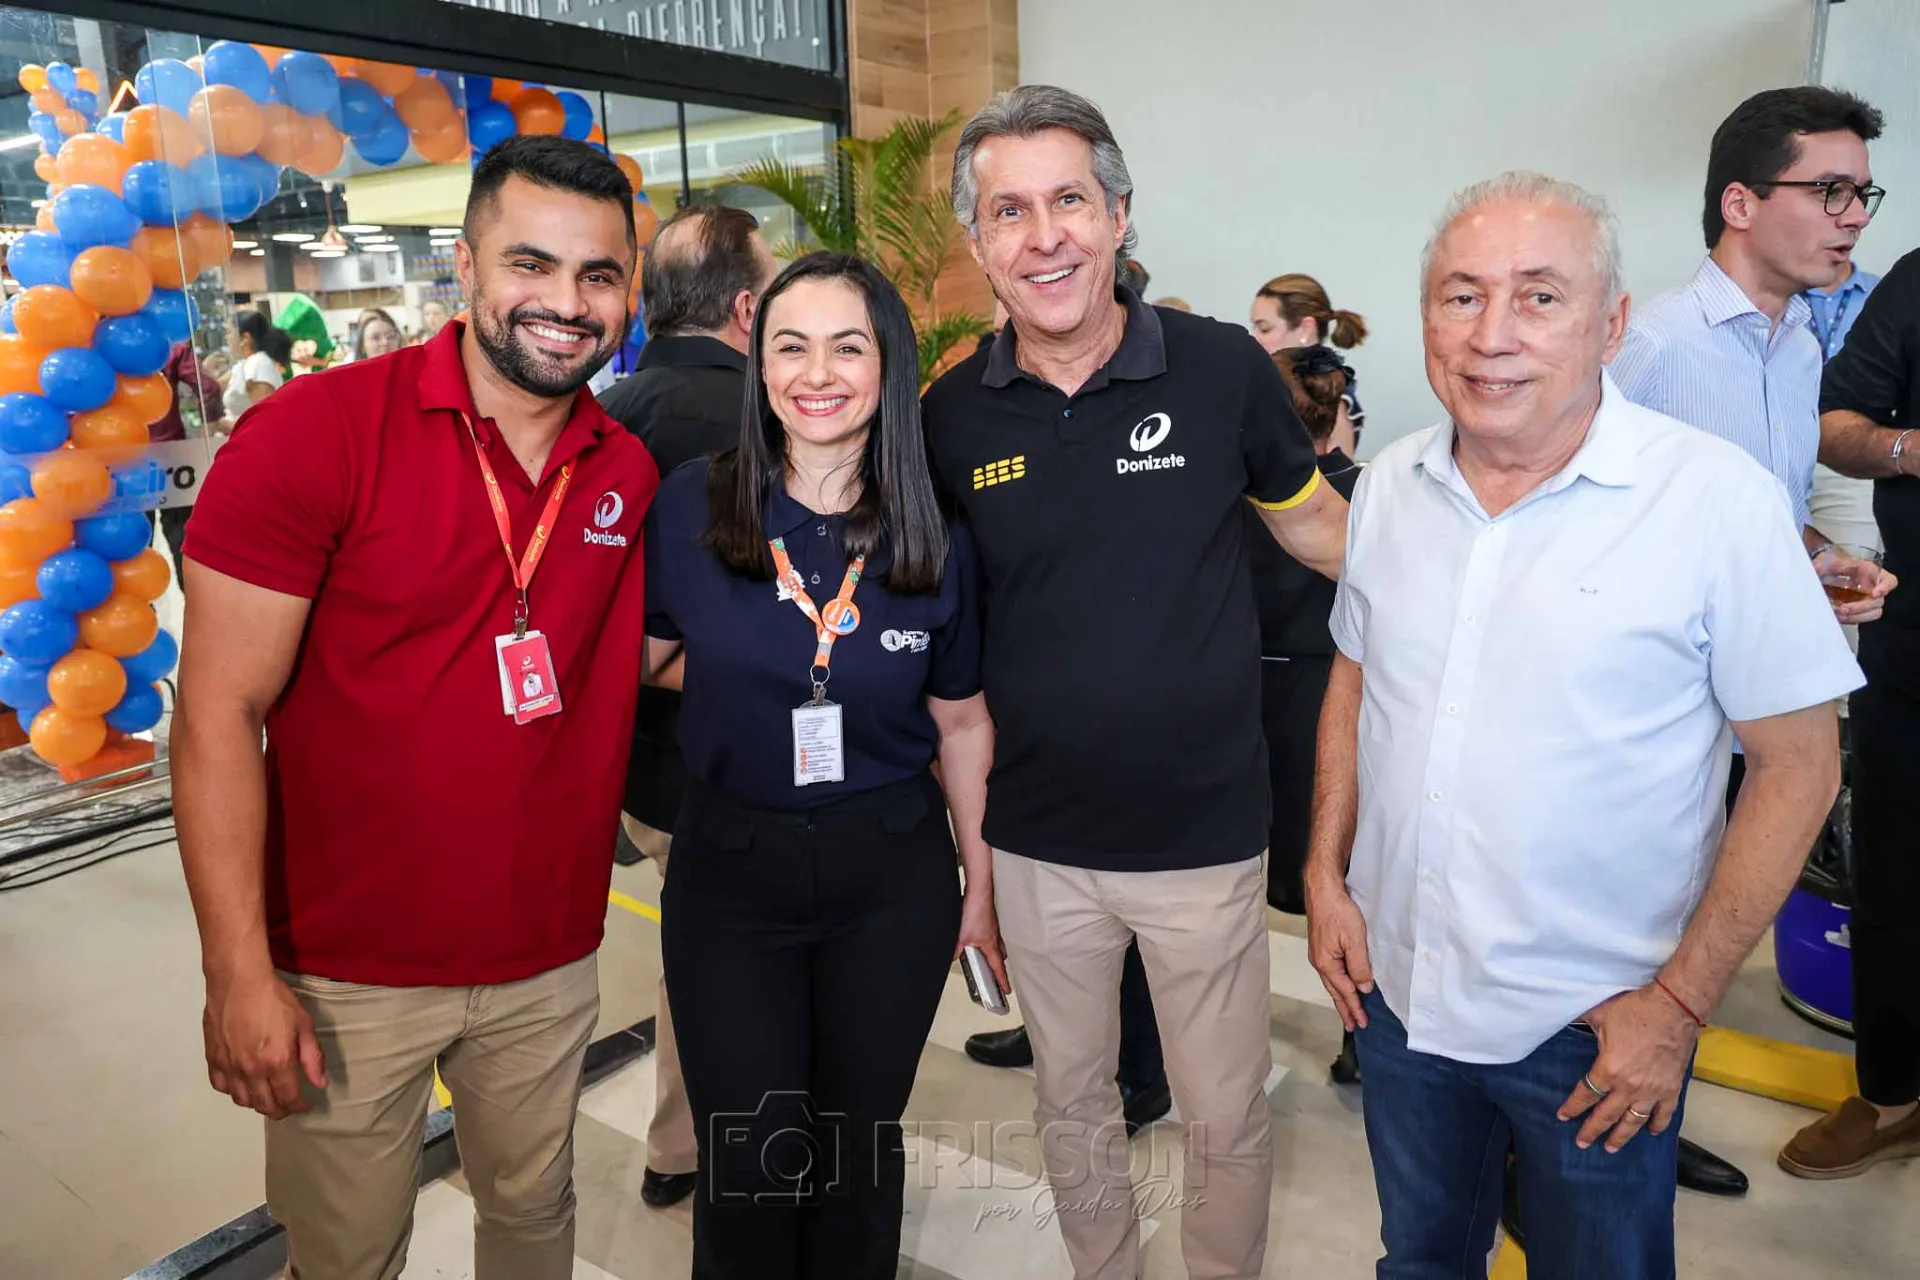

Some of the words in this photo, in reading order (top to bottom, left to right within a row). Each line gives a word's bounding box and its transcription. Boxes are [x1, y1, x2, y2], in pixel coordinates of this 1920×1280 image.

[973, 455, 1026, 490] BEES
[1116, 453, 1186, 474] Donizete
[584, 527, 627, 547] Donizete
